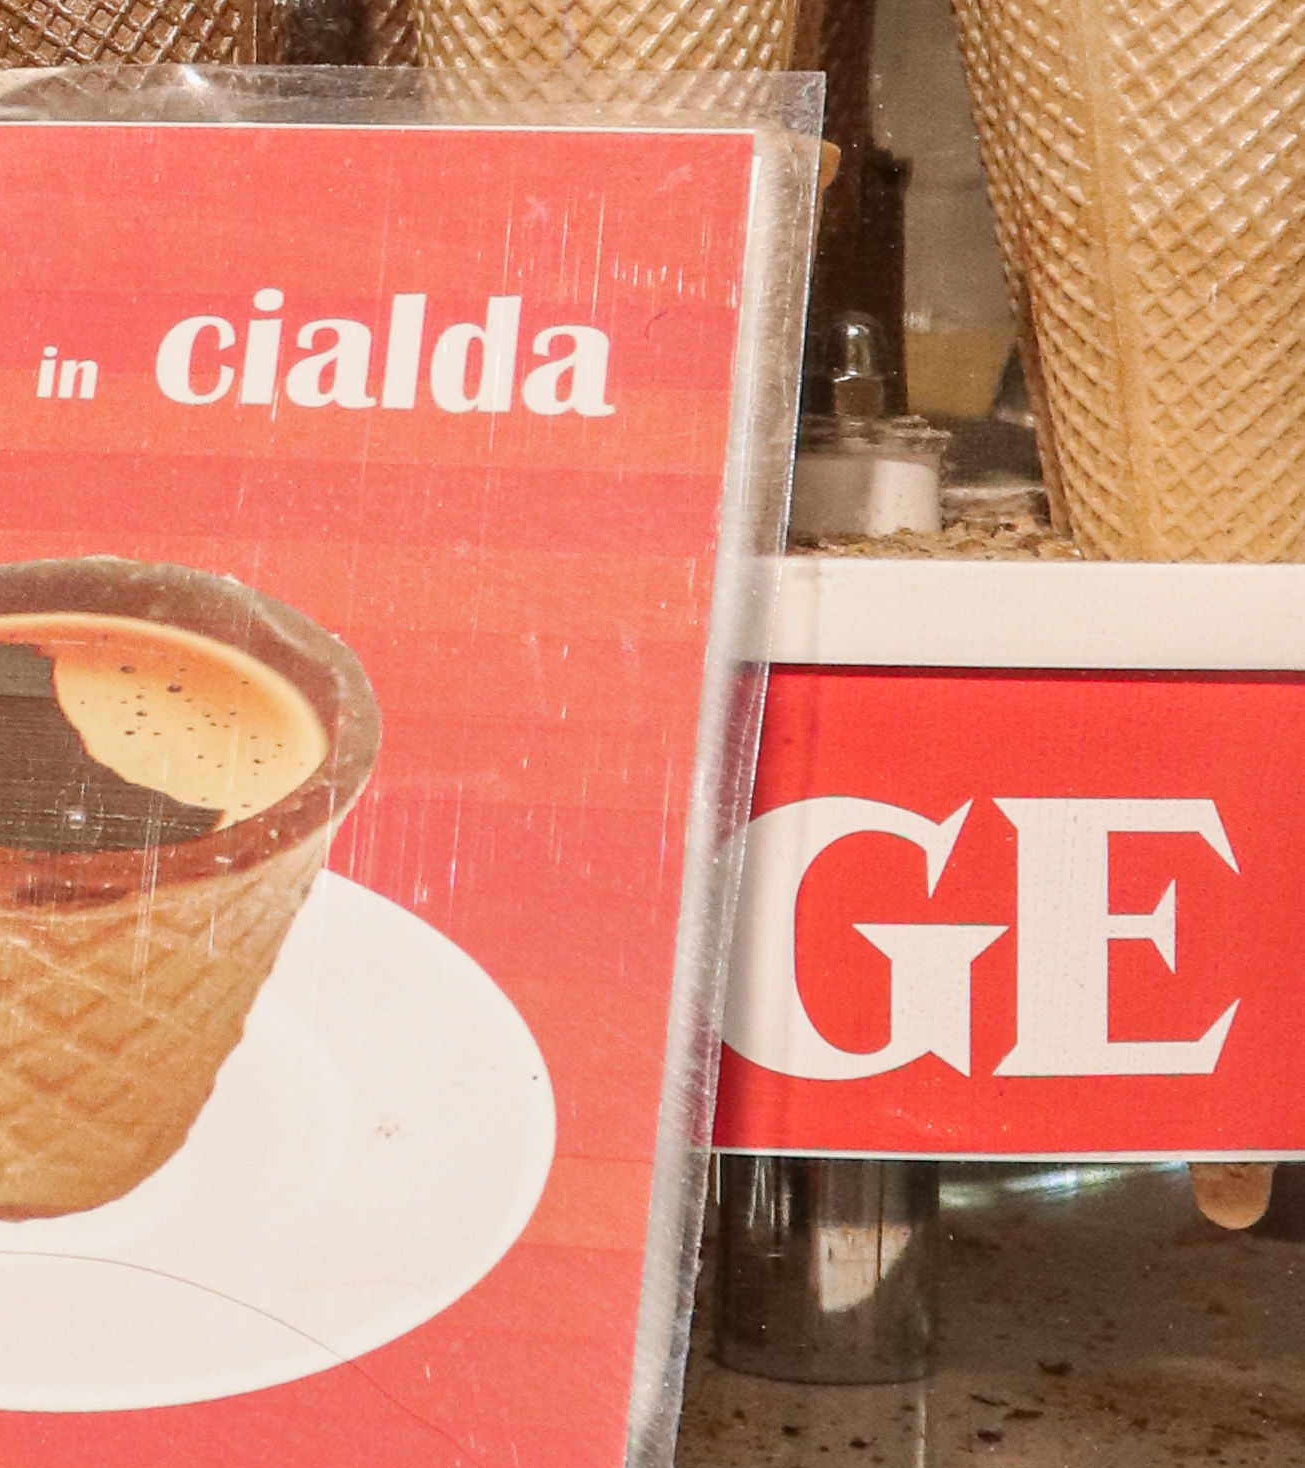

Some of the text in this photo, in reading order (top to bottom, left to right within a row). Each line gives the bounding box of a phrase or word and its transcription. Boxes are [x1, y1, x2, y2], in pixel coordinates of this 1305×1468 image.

[36, 345, 99, 402] in
[154, 286, 617, 419] cialda
[715, 795, 1241, 1081] GE
